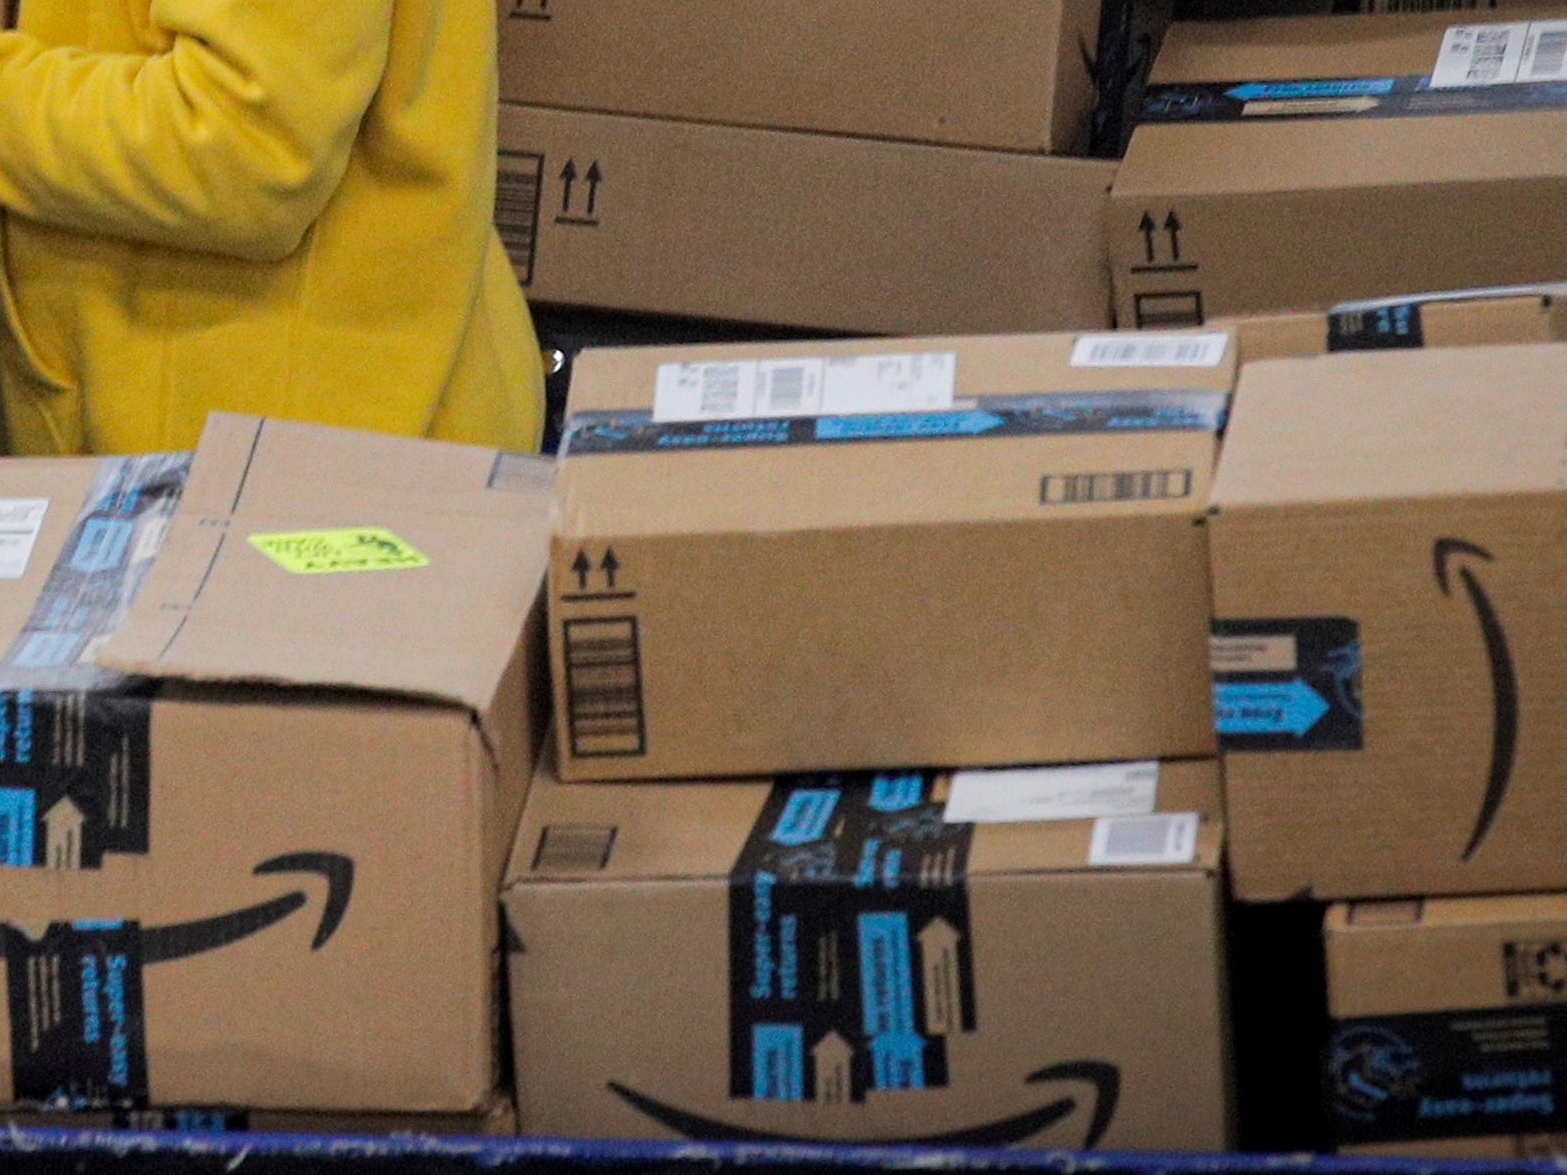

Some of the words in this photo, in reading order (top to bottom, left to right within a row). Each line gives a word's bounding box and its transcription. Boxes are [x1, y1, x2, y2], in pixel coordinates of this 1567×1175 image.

[750, 871, 779, 999] Super-easy
[779, 915, 799, 999] returns
[80, 954, 101, 1044] returns
[102, 953, 128, 1085] Super-easy
[1419, 1091, 1554, 1116] Super-easy
